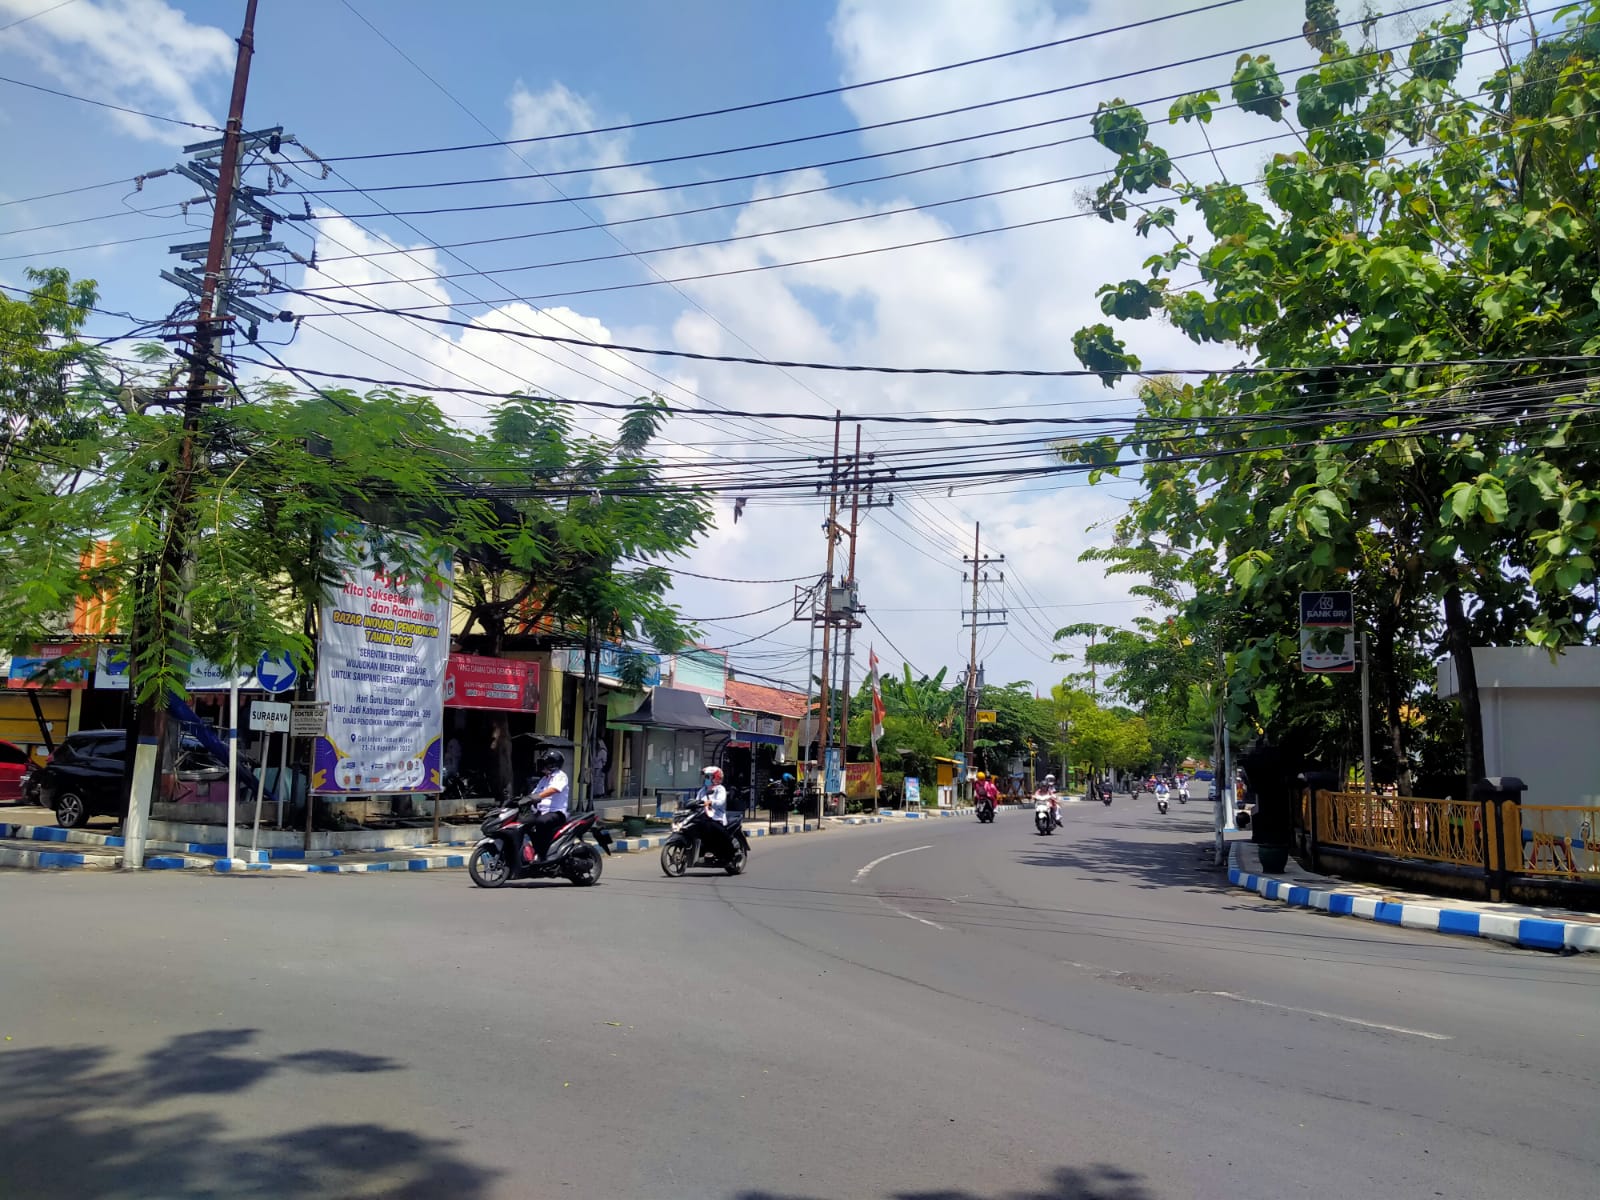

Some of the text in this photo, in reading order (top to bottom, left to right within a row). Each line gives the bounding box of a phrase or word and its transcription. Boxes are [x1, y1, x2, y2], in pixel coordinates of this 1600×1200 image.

[366, 586, 414, 606] Sukseskan
[371, 602, 434, 622] dan Ramaikan
[1306, 610, 1331, 618] BANK
[333, 610, 439, 638] BAZAR INOVASI PENDIDIKAN
[365, 630, 414, 648] TAHUN 2022
[345, 658, 378, 670] WUJUDKAN
[380, 662, 404, 673] MERDEKA
[331, 670, 351, 680] UNTUK
[353, 672, 380, 682] SAMPANG
[252, 711, 288, 722] SURABAYA
